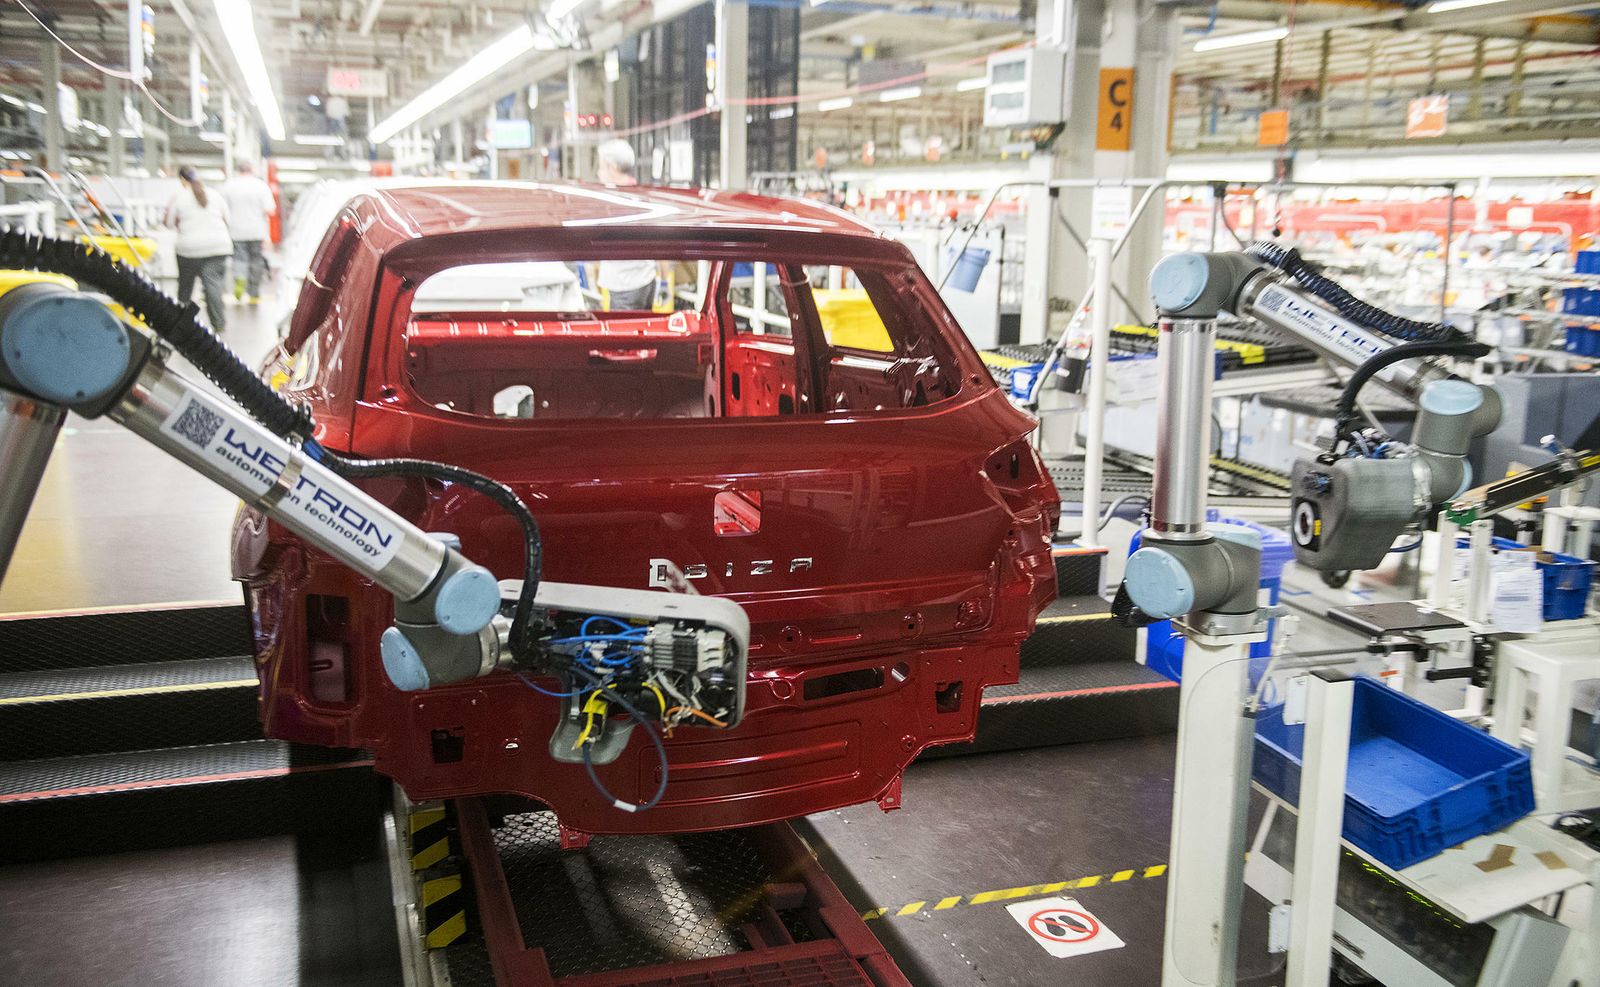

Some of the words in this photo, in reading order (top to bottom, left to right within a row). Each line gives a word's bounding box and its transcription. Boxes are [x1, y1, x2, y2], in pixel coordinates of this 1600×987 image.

[1108, 79, 1127, 108] C
[1110, 111, 1123, 132] 4
[215, 446, 301, 505] automaon
[305, 500, 381, 558] technology
[224, 428, 393, 548] WETRON
